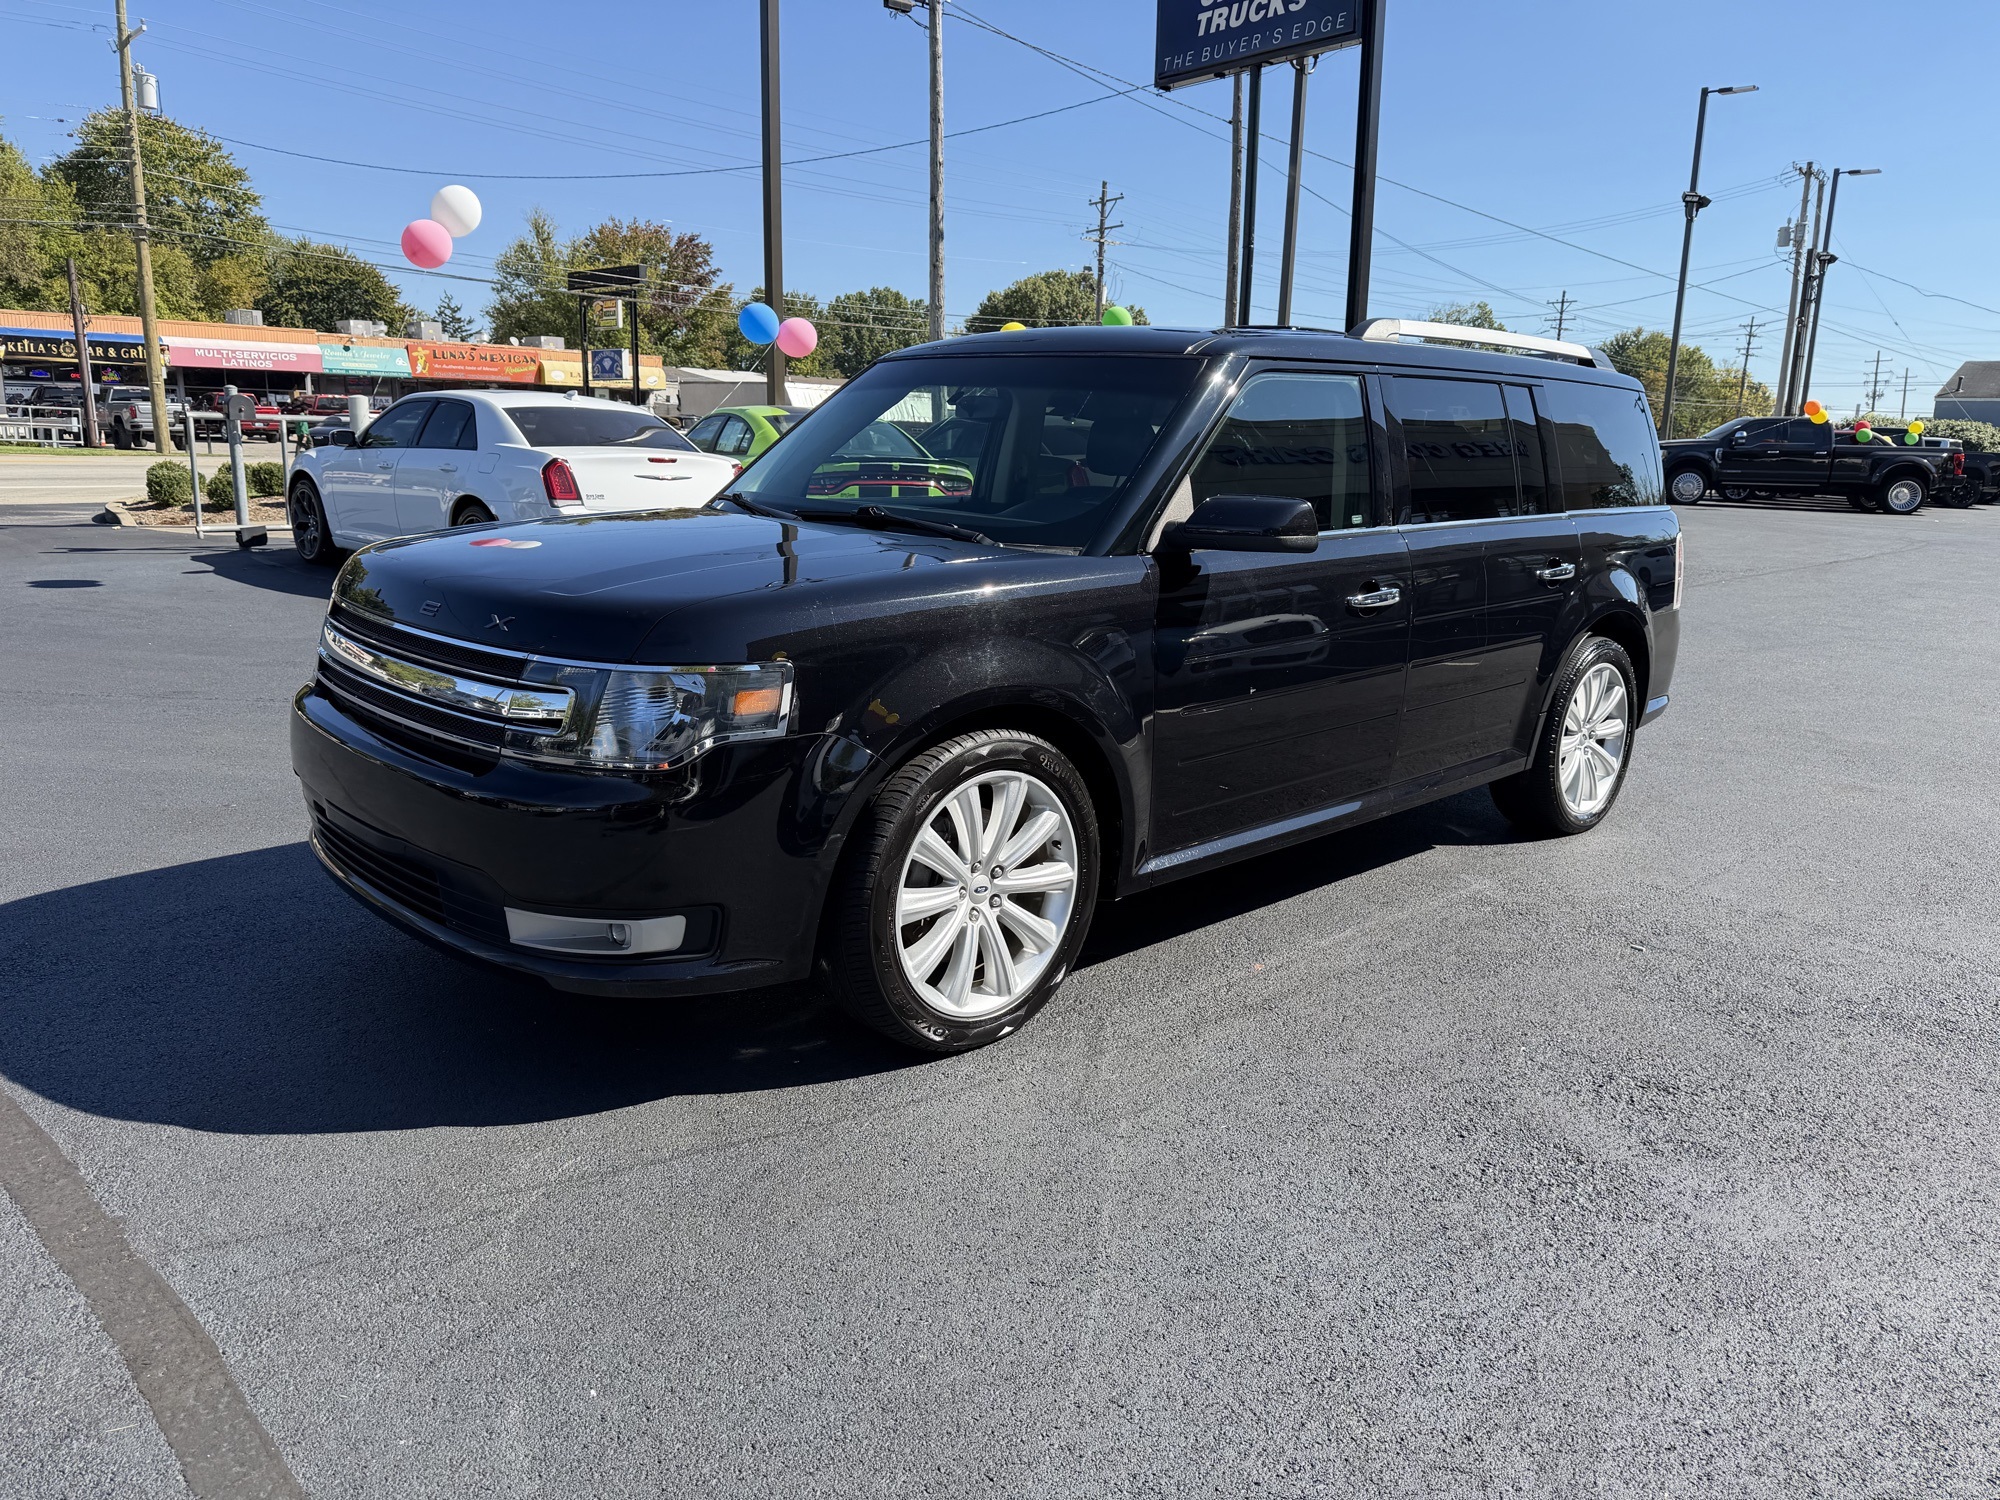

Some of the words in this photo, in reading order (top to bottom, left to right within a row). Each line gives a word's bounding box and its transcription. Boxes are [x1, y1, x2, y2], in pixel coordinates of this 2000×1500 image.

[1164, 51, 1195, 72] THE
[1201, 28, 1283, 62] BUYER'S
[1291, 12, 1348, 40] EDGE
[87, 346, 105, 357] AR
[107, 347, 117, 358] &
[194, 349, 298, 361] MULTI-SERVICIOS
[432, 349, 476, 361] LUNA'S
[480, 352, 537, 365] MEXICAN
[222, 358, 274, 368] LATINOS
